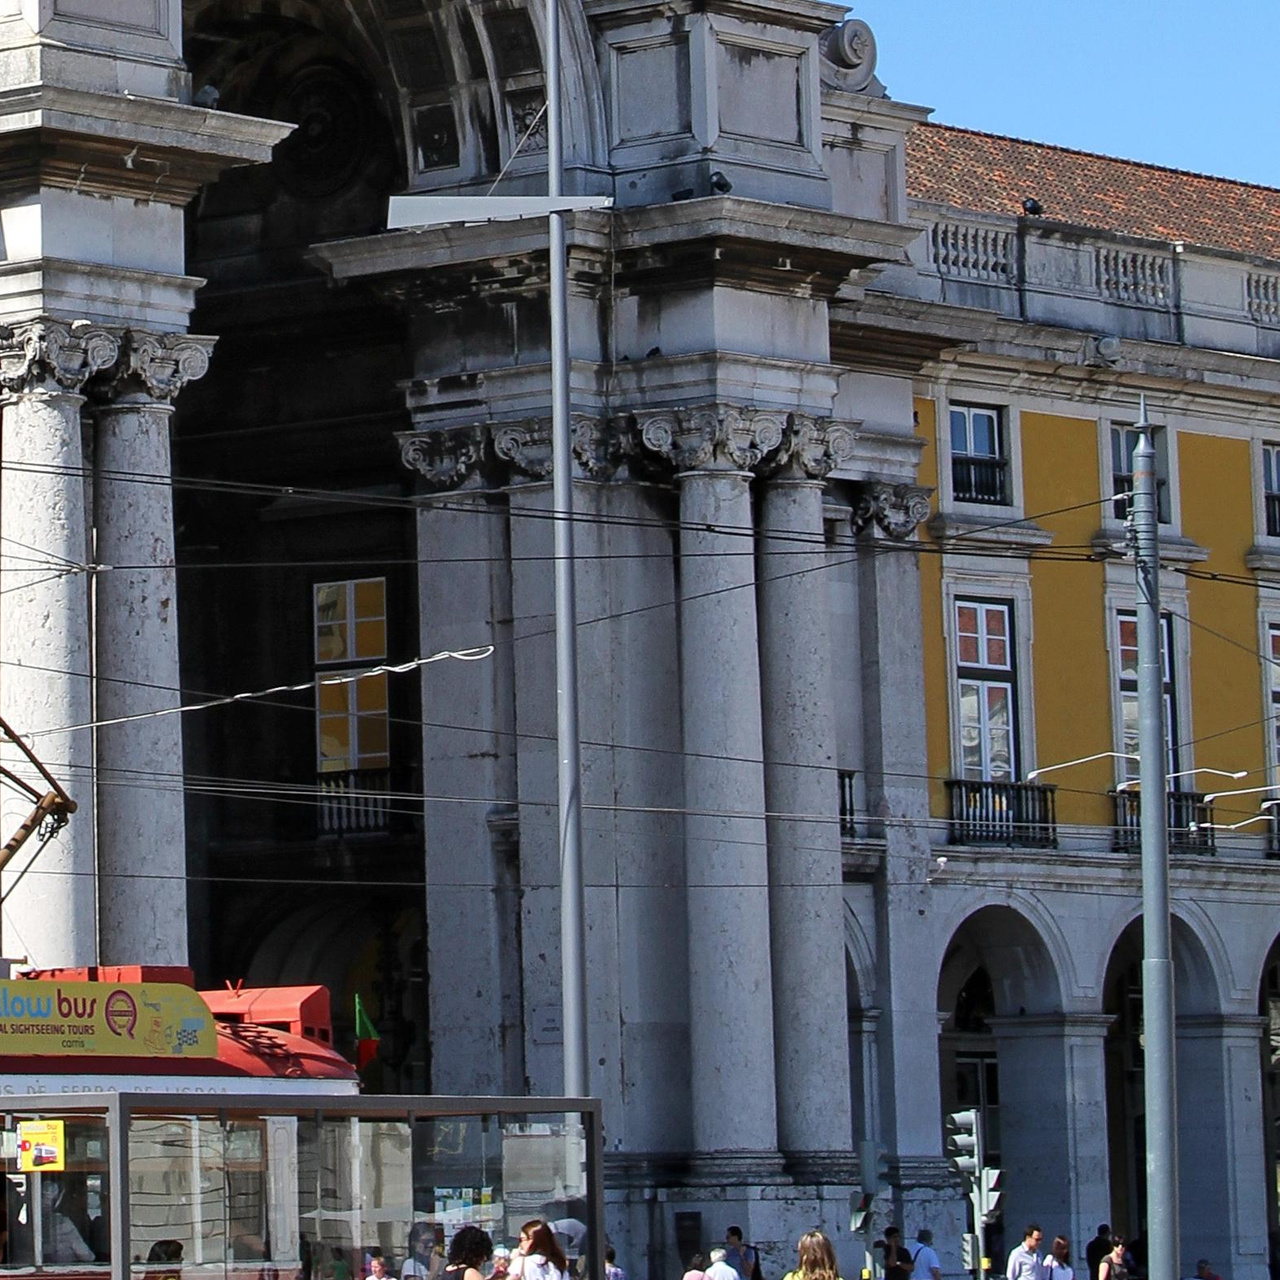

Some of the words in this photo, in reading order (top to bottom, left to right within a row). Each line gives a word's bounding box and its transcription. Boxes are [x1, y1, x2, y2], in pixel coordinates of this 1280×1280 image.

[57, 988, 97, 1018] bus
[10, 1024, 65, 1035] SIGHTSEEING
[67, 1025, 95, 1035] TOURS
